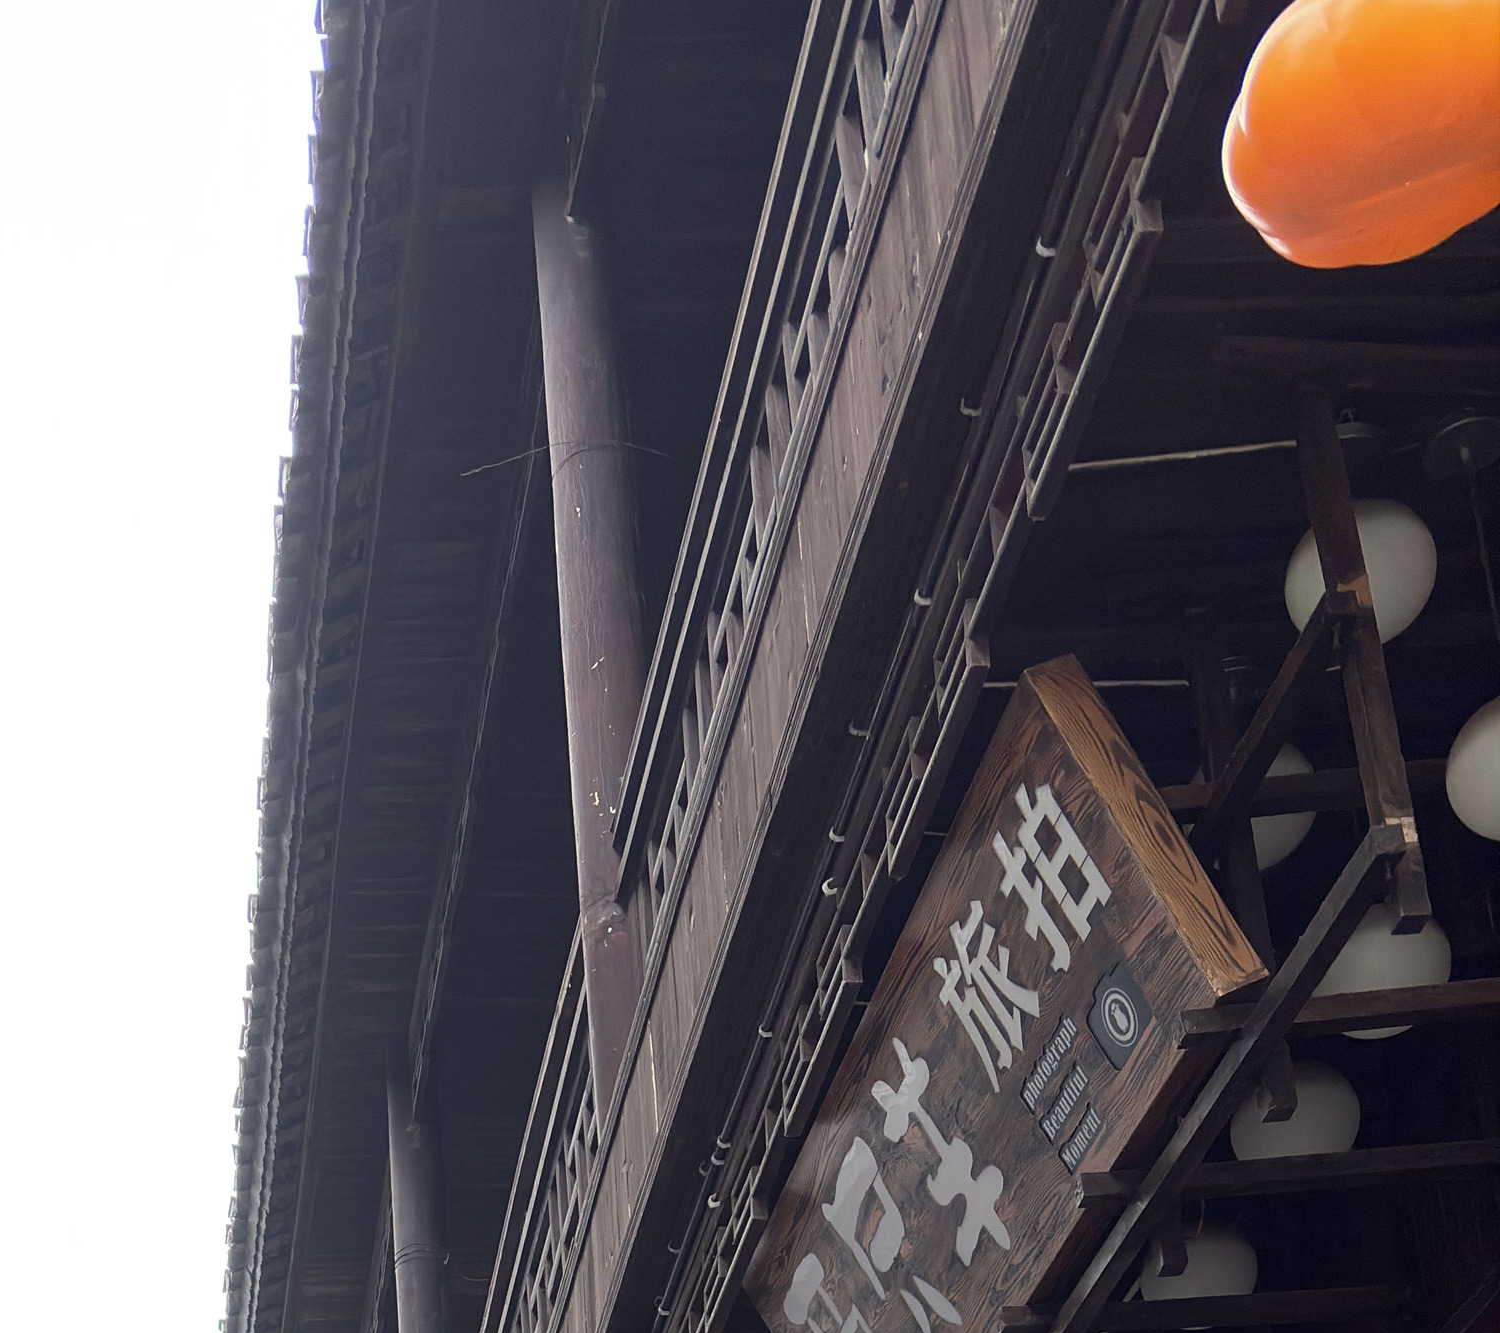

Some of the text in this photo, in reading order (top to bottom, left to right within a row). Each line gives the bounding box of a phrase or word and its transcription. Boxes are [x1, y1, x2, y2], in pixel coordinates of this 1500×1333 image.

[1022, 1016, 1078, 1110] photograph
[1041, 1065, 1089, 1141] Beautiful
[1061, 1107, 1102, 1171] Moment
